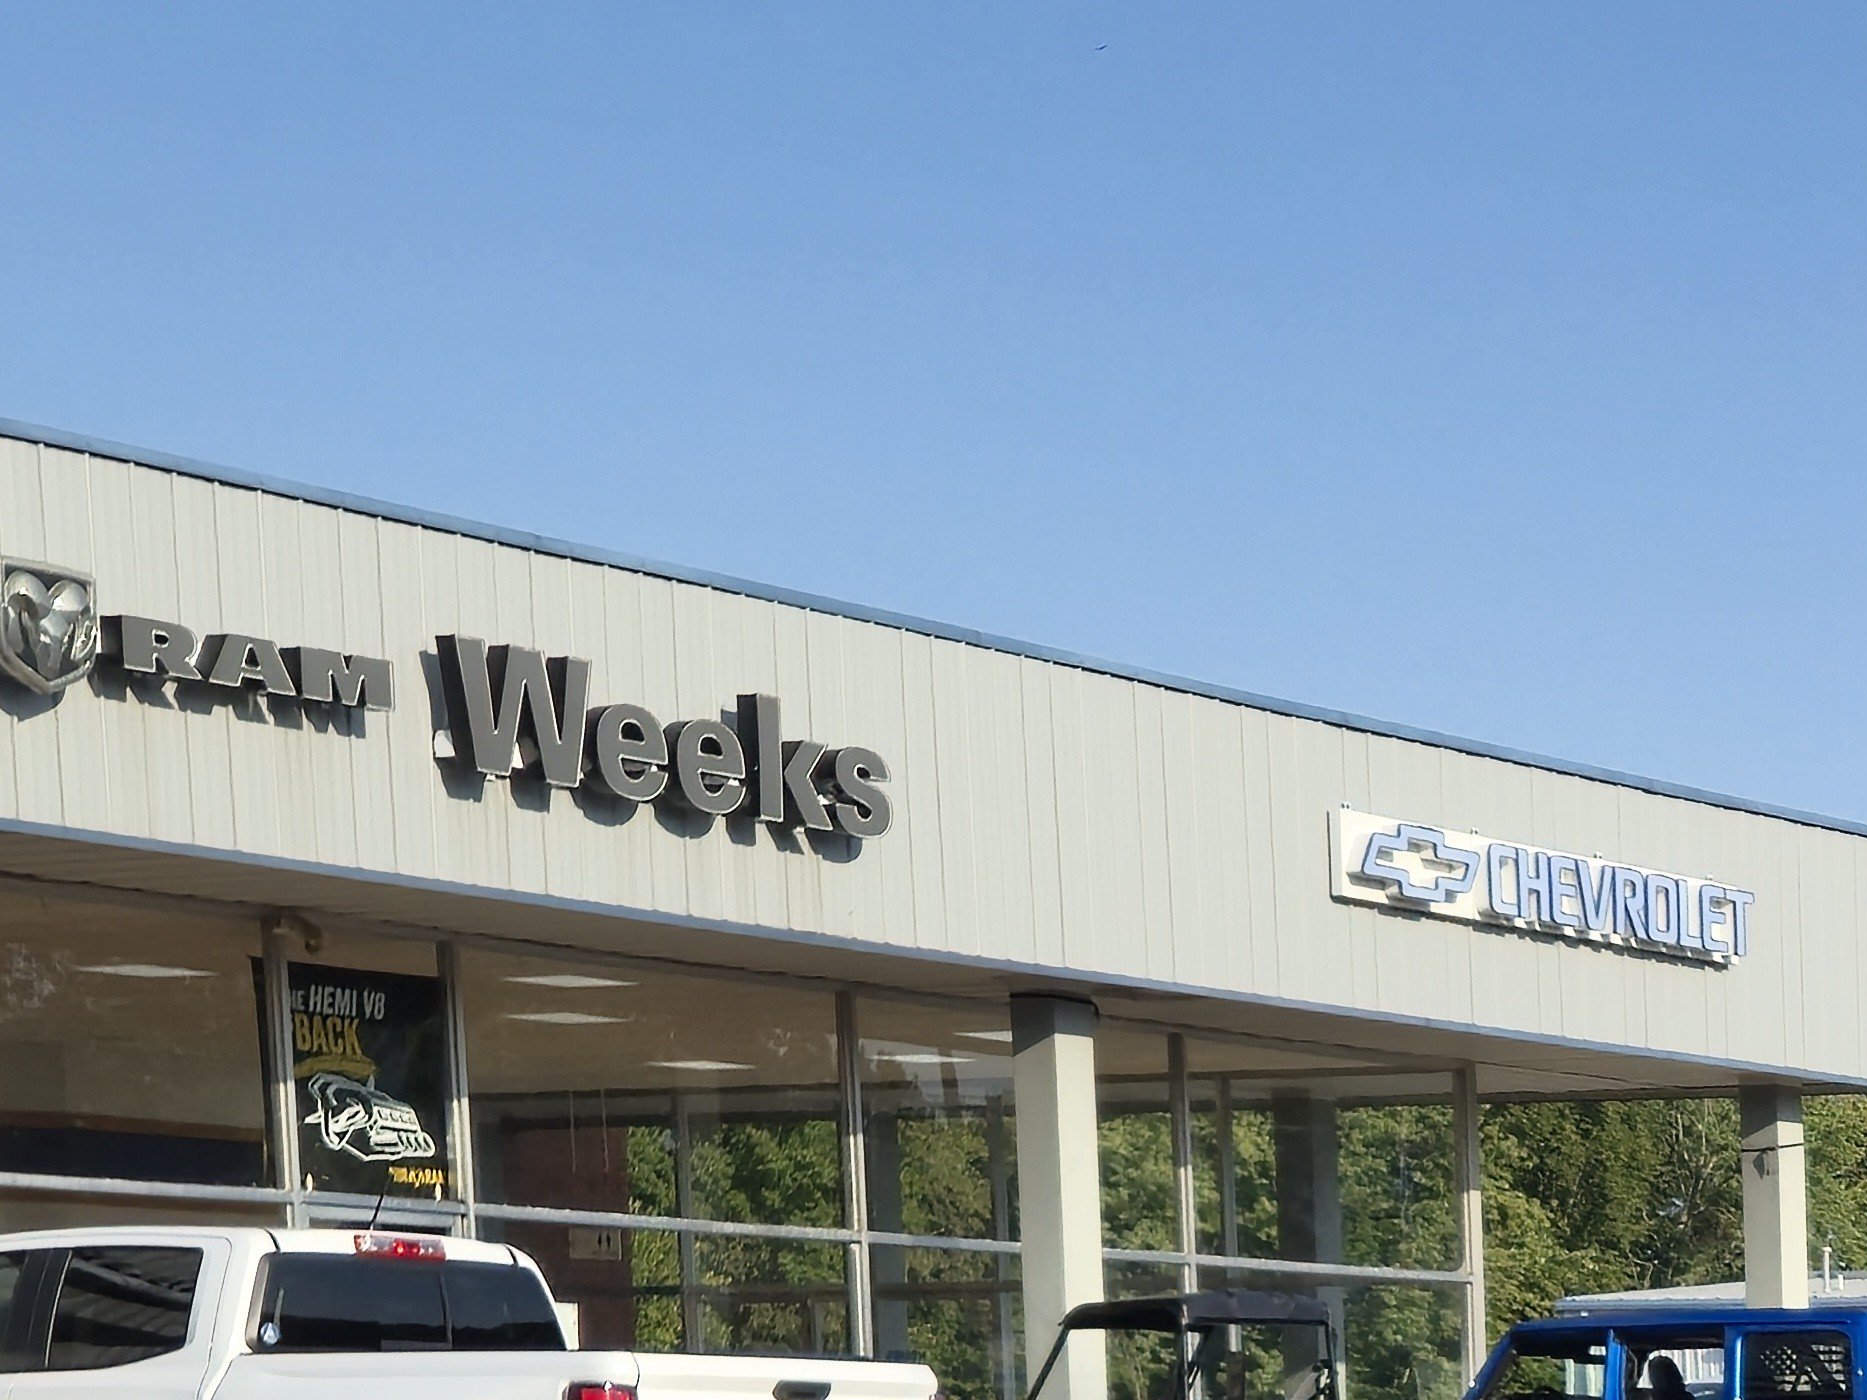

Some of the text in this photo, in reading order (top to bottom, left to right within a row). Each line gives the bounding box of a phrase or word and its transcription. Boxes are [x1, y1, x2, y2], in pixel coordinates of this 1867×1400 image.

[101, 614, 394, 712] RAM
[434, 634, 893, 839] Weeks
[1486, 842, 1755, 957] CHEVROLET
[294, 1011, 363, 1060] BACK
[309, 984, 357, 1017] HEMI
[363, 987, 386, 1020] V8
